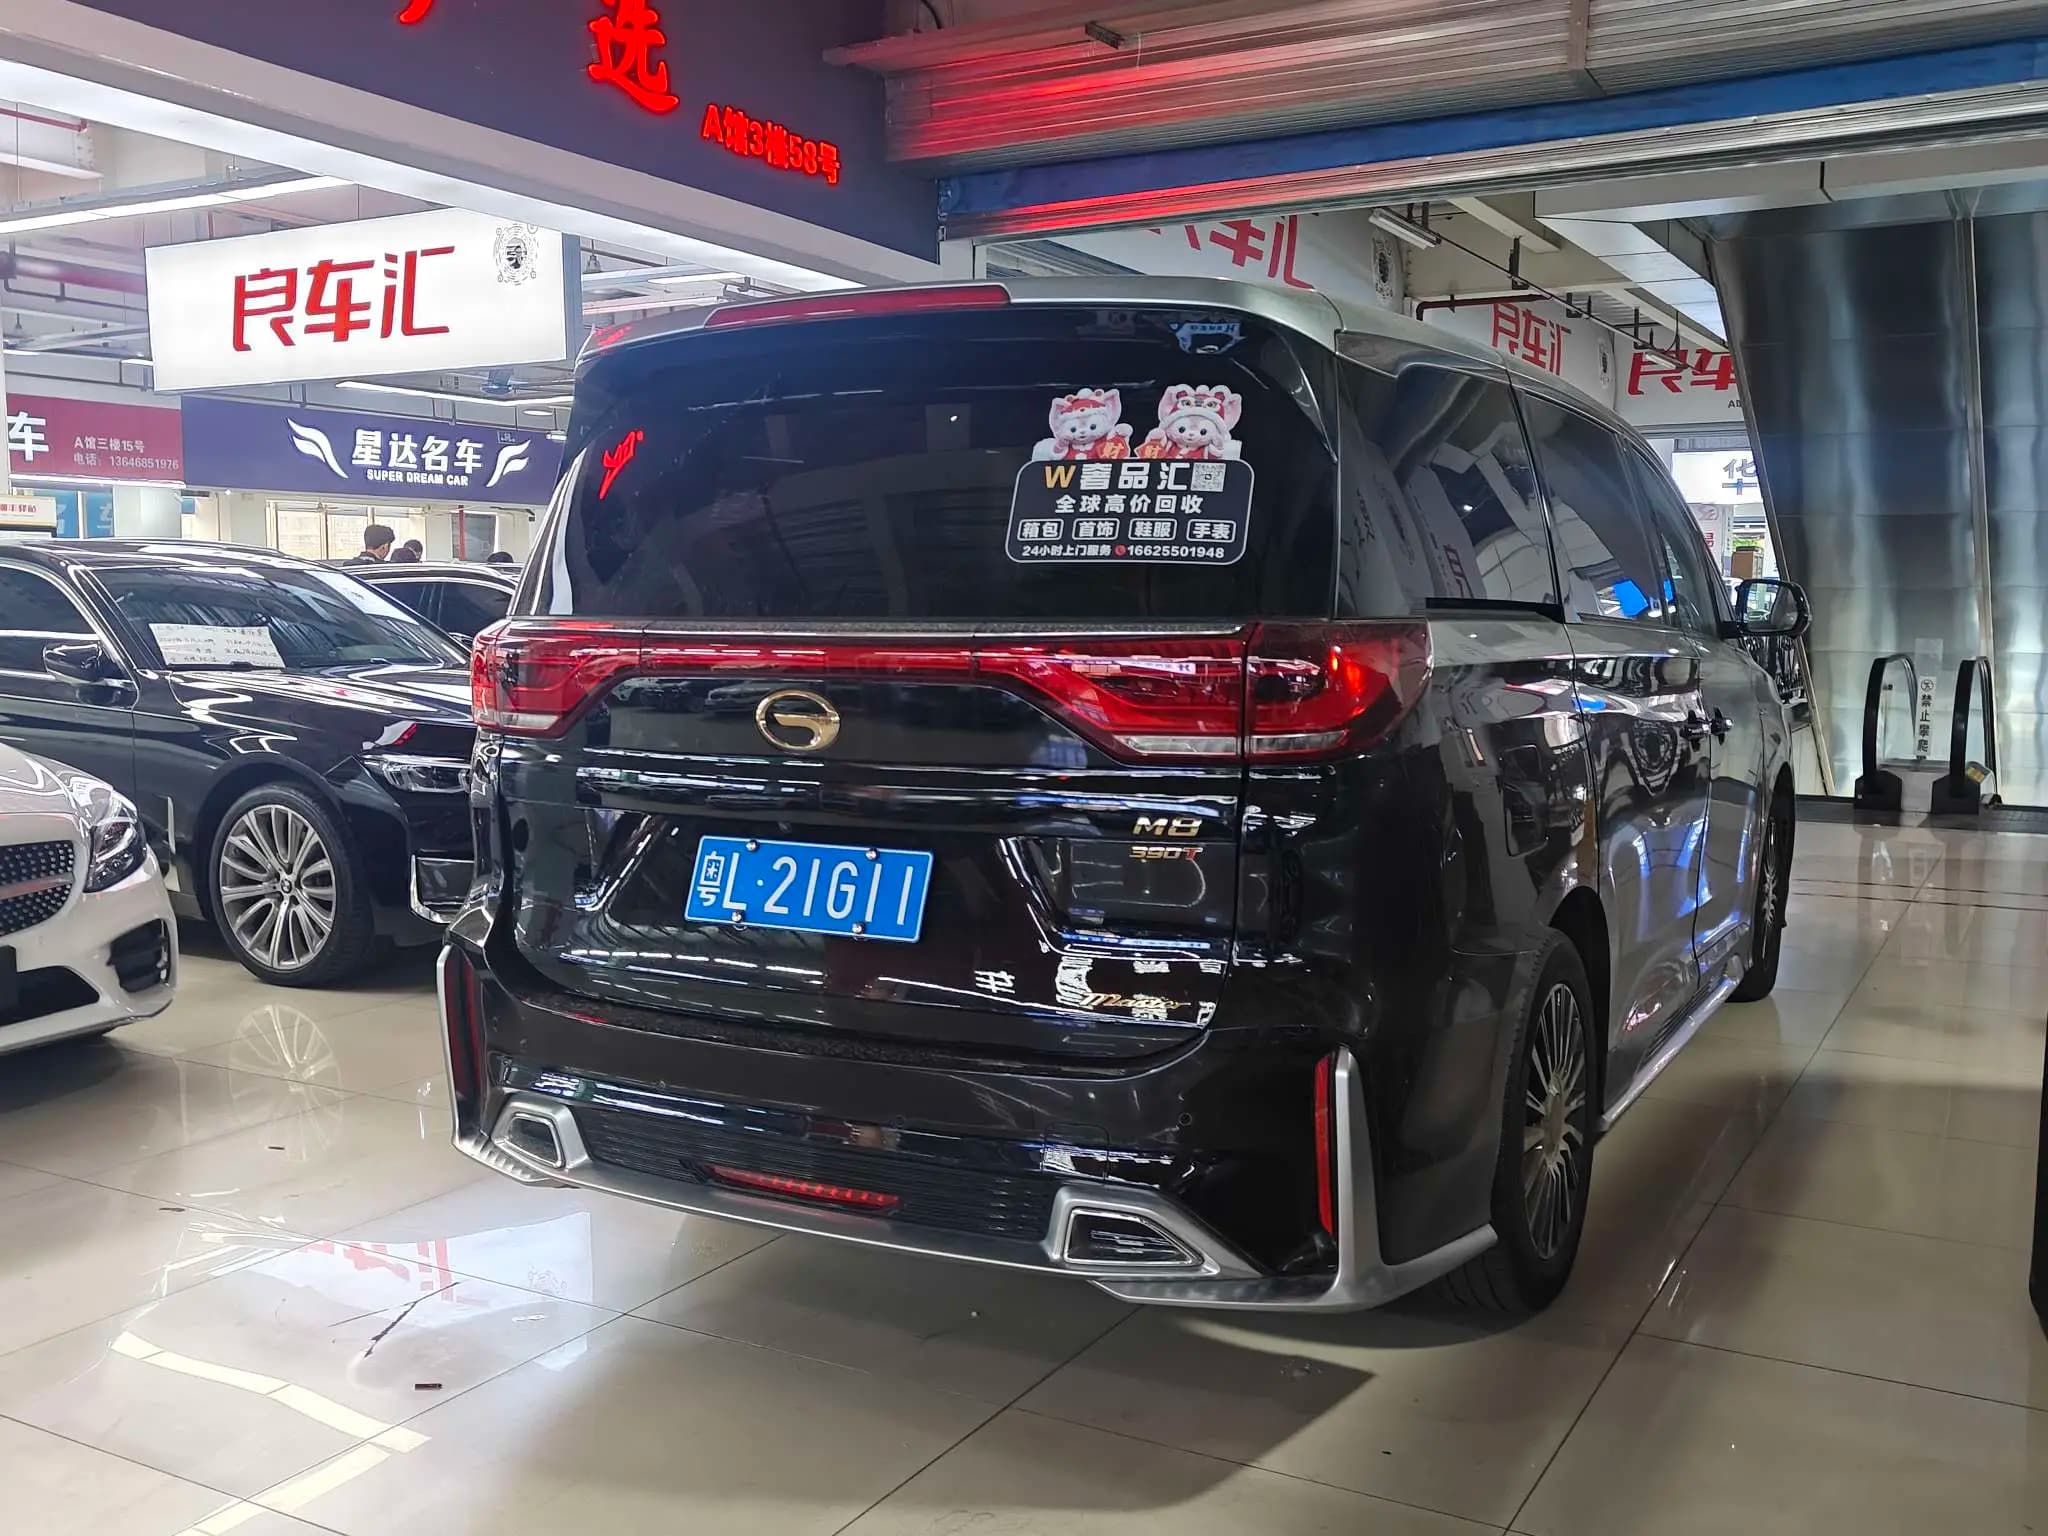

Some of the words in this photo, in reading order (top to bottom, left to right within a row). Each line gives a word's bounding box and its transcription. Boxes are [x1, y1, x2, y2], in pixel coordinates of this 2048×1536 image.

[232, 246, 455, 352] 良车汇
[8, 411, 50, 463] 车
[351, 428, 484, 475] 星达名车
[366, 468, 404, 483] SUPER
[406, 472, 444, 485] DREAM
[446, 474, 469, 487] CAR
[1044, 465, 1076, 489] W
[1055, 494, 1204, 515] 全球高价回收
[1022, 522, 1059, 539] 箱包
[1078, 521, 1115, 538] 首饰
[1134, 521, 1172, 538] 鞋服
[1193, 522, 1231, 541] 手表
[1127, 545, 1225, 559] 16625501948
[1132, 816, 1203, 837] M8
[1129, 845, 1204, 861] 390T
